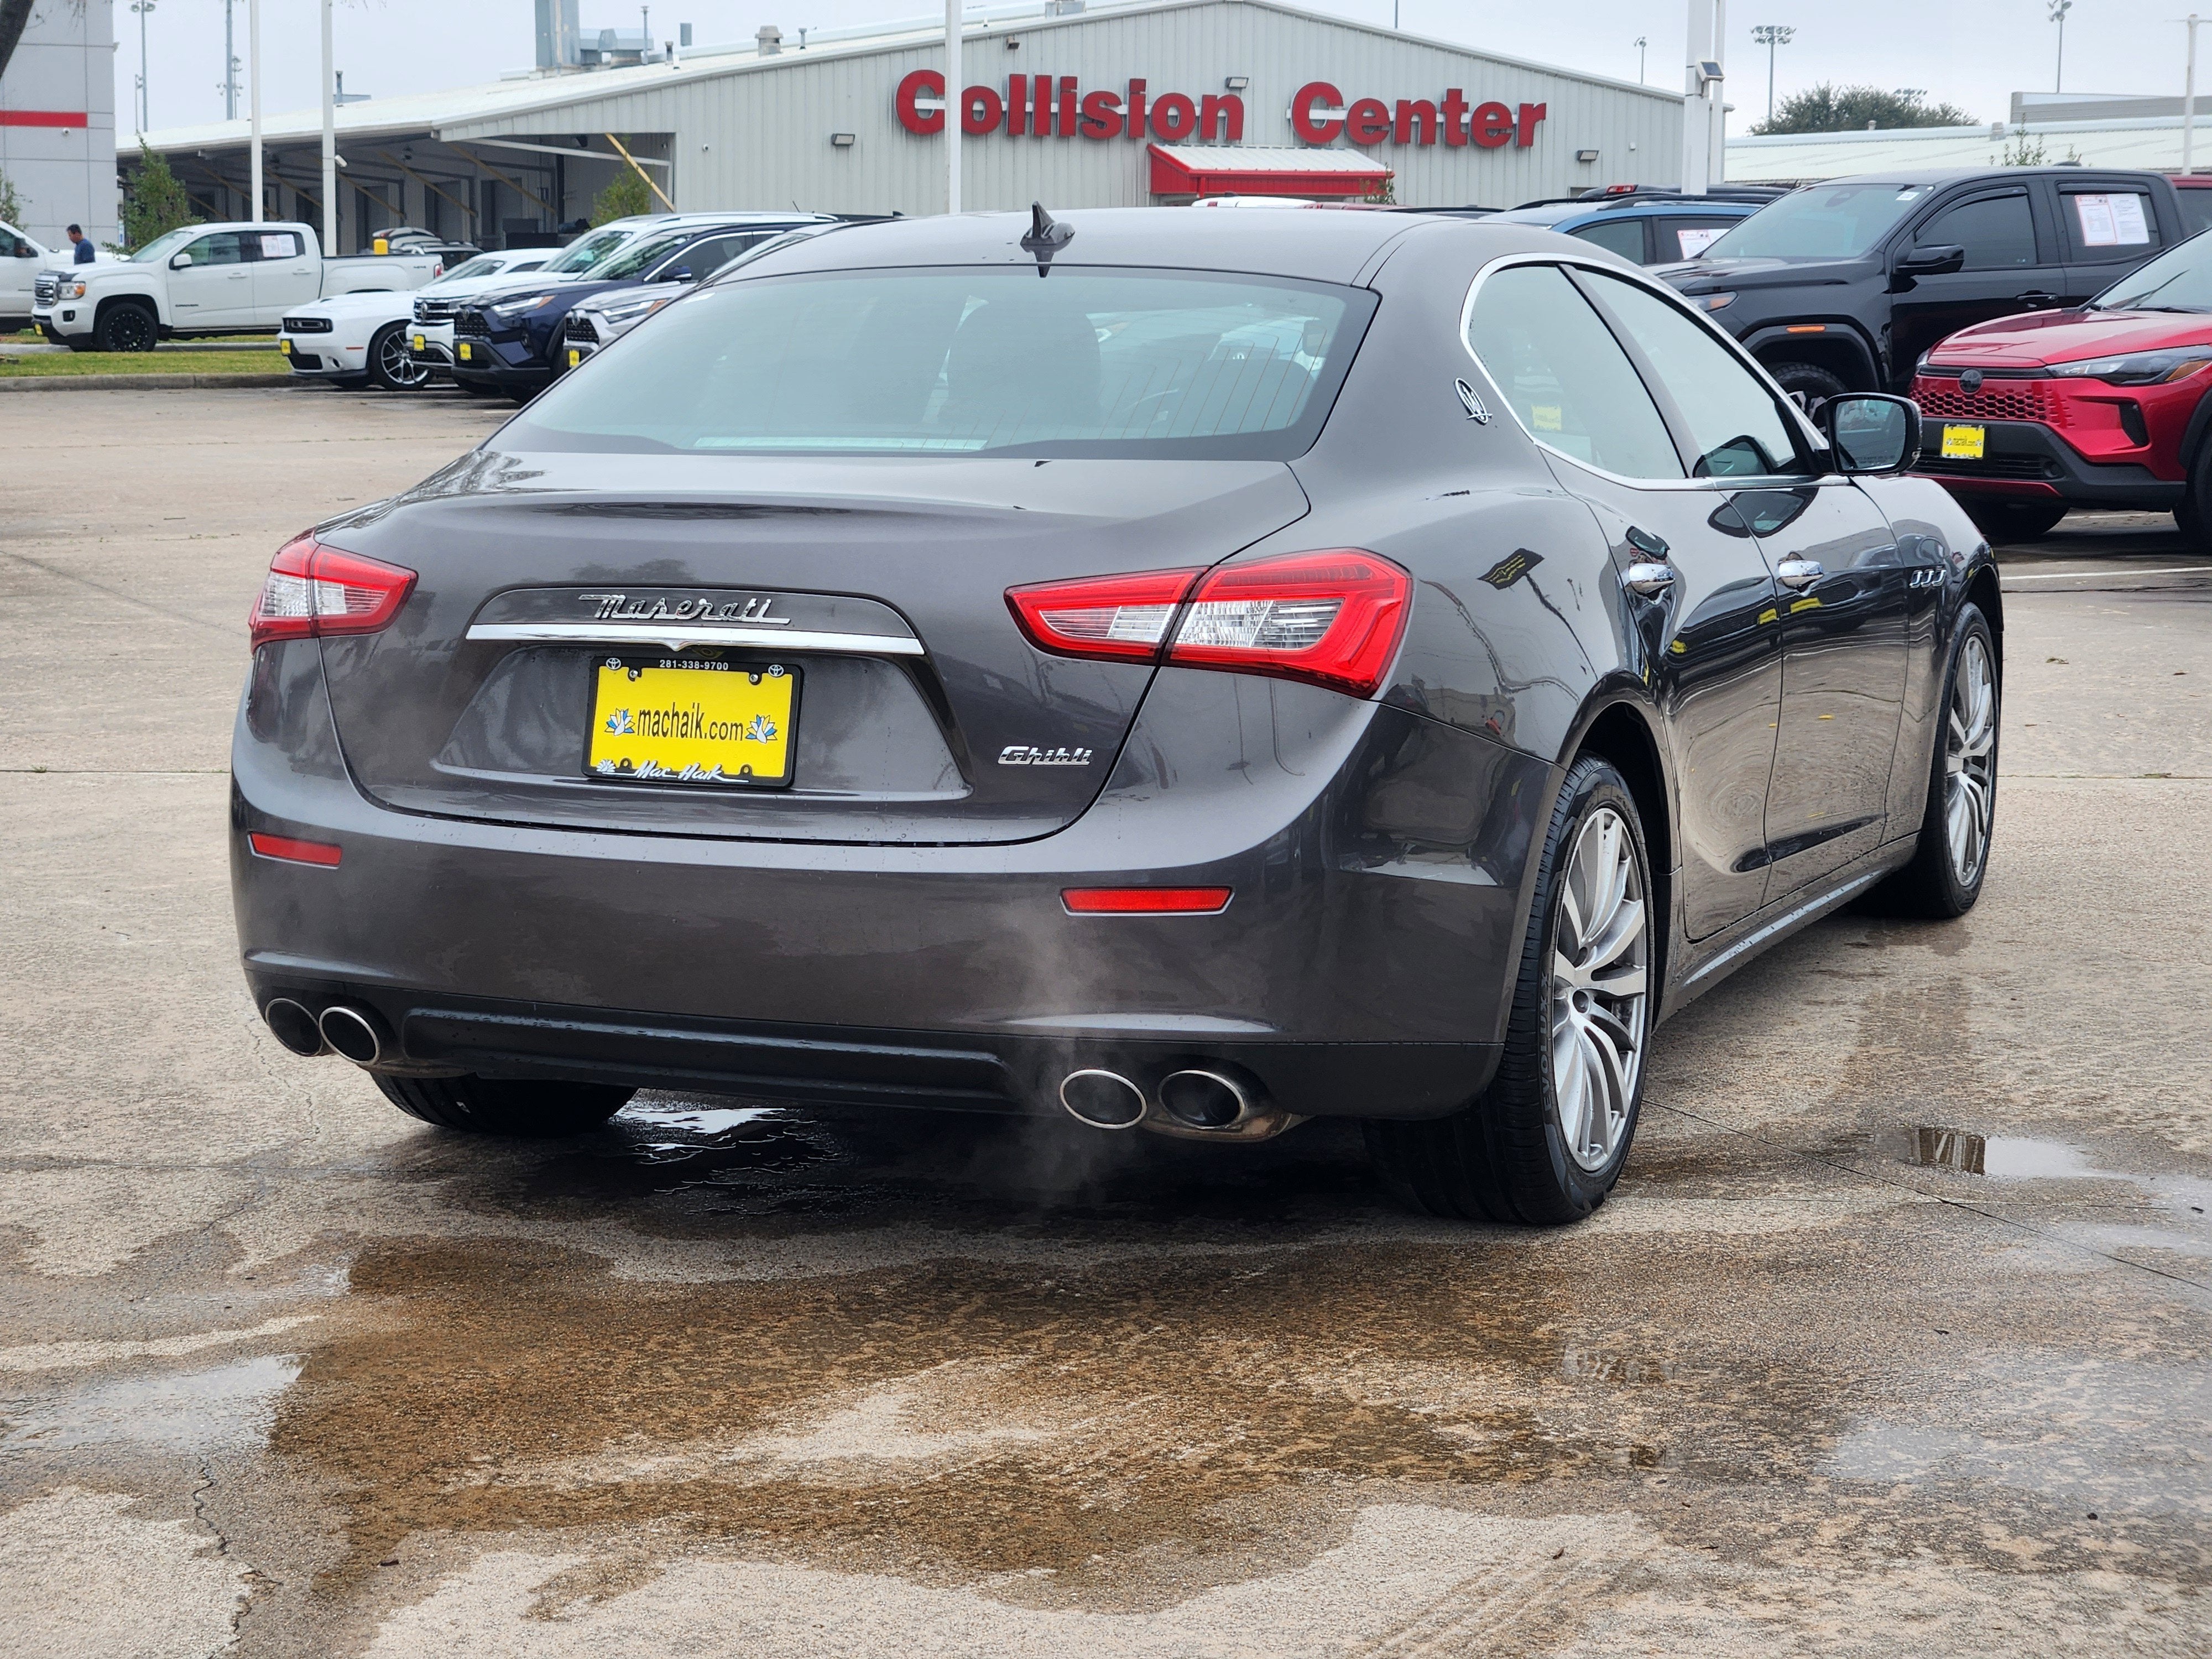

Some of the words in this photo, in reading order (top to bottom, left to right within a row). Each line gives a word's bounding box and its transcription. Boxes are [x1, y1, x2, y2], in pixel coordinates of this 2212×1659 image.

[896, 69, 1244, 140] Collision
[1290, 81, 1547, 148] Center
[578, 594, 791, 625] Maserati
[659, 659, 729, 671] 281-338-9700
[637, 702, 743, 741] machaik.com
[998, 745, 1093, 765] Ghibli
[635, 760, 677, 779] Mac
